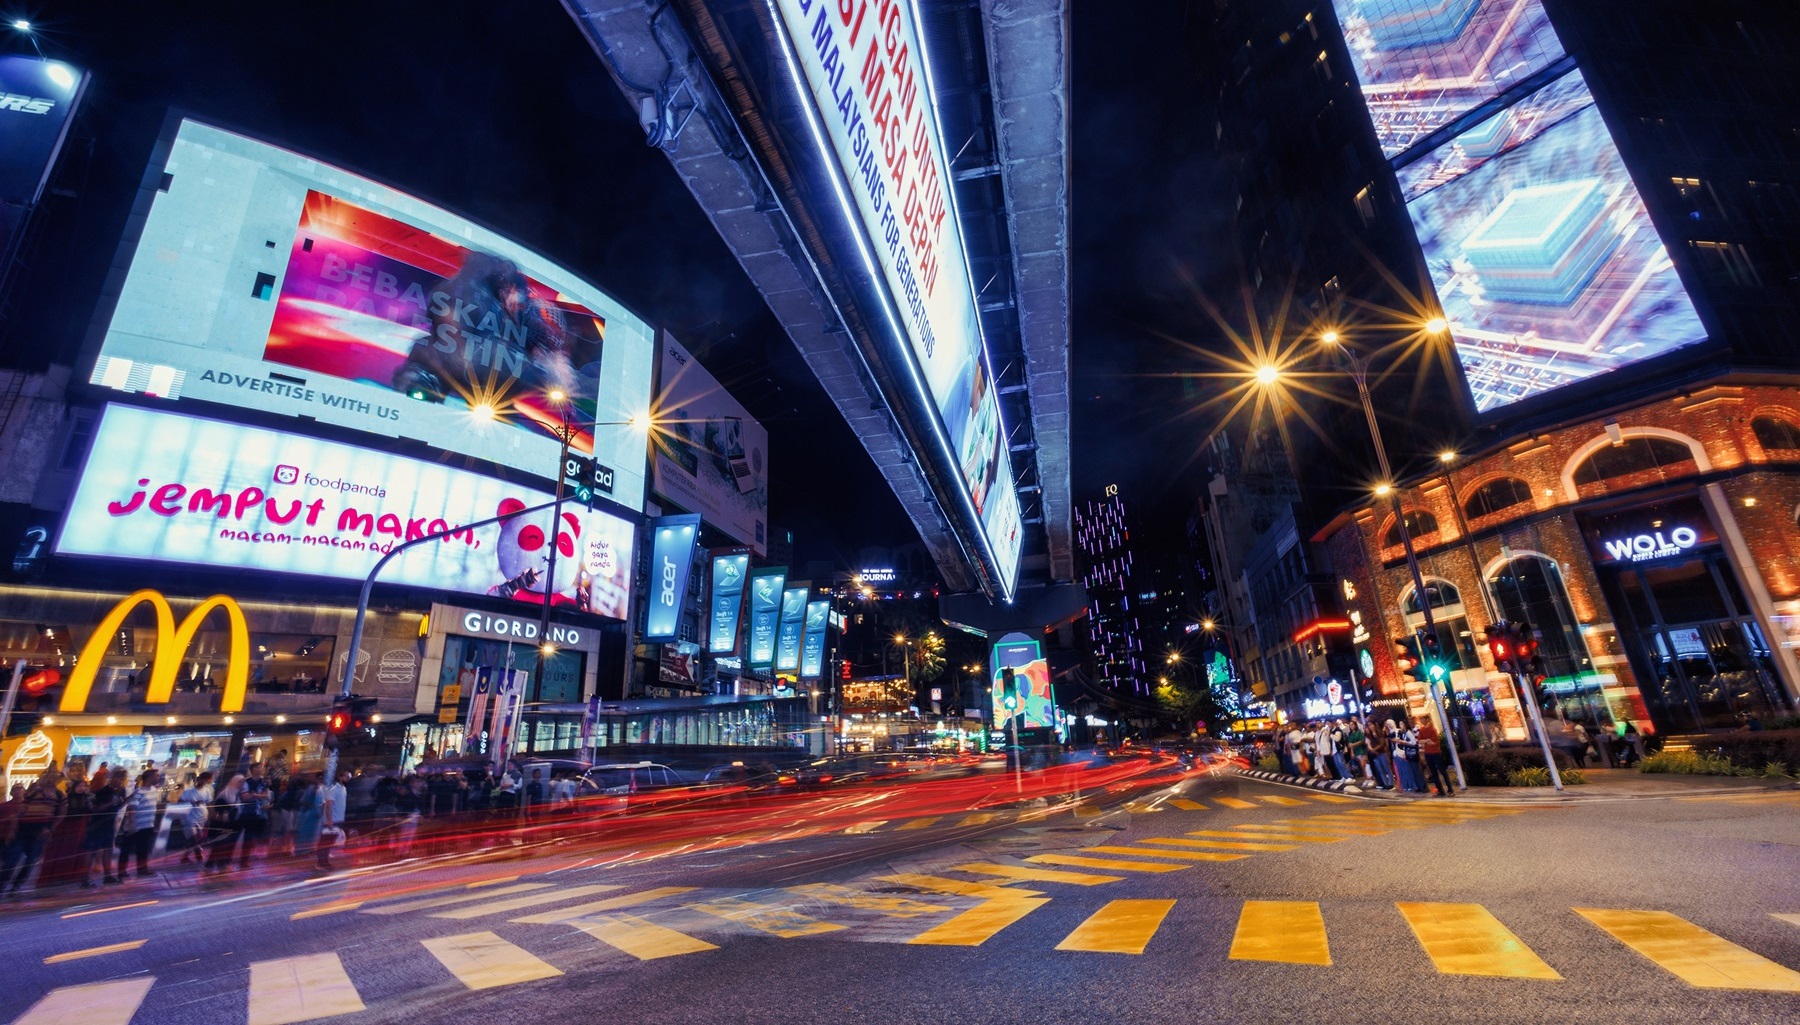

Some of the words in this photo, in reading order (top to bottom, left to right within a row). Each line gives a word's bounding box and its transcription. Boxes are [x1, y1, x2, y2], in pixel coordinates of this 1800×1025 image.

[811, 4, 885, 213] MALAYSIANS
[880, 200, 900, 258] FOR
[896, 245, 935, 359] GENERATIONS
[860, 33, 907, 198] MASA
[903, 176, 938, 299] DEPAN
[912, 108, 945, 244] UNTUK
[320, 252, 528, 348] BEBASKAN
[669, 346, 688, 366] acer
[199, 369, 315, 402] ADVERTISE
[321, 392, 371, 415] WITH
[376, 405, 400, 421] US
[107, 478, 325, 527] jemput
[303, 473, 387, 498] foodpanda
[1105, 484, 1118, 497] EQ
[219, 529, 365, 551] macam-macam
[1605, 527, 1697, 561] WOLO
[661, 555, 677, 607] acer
